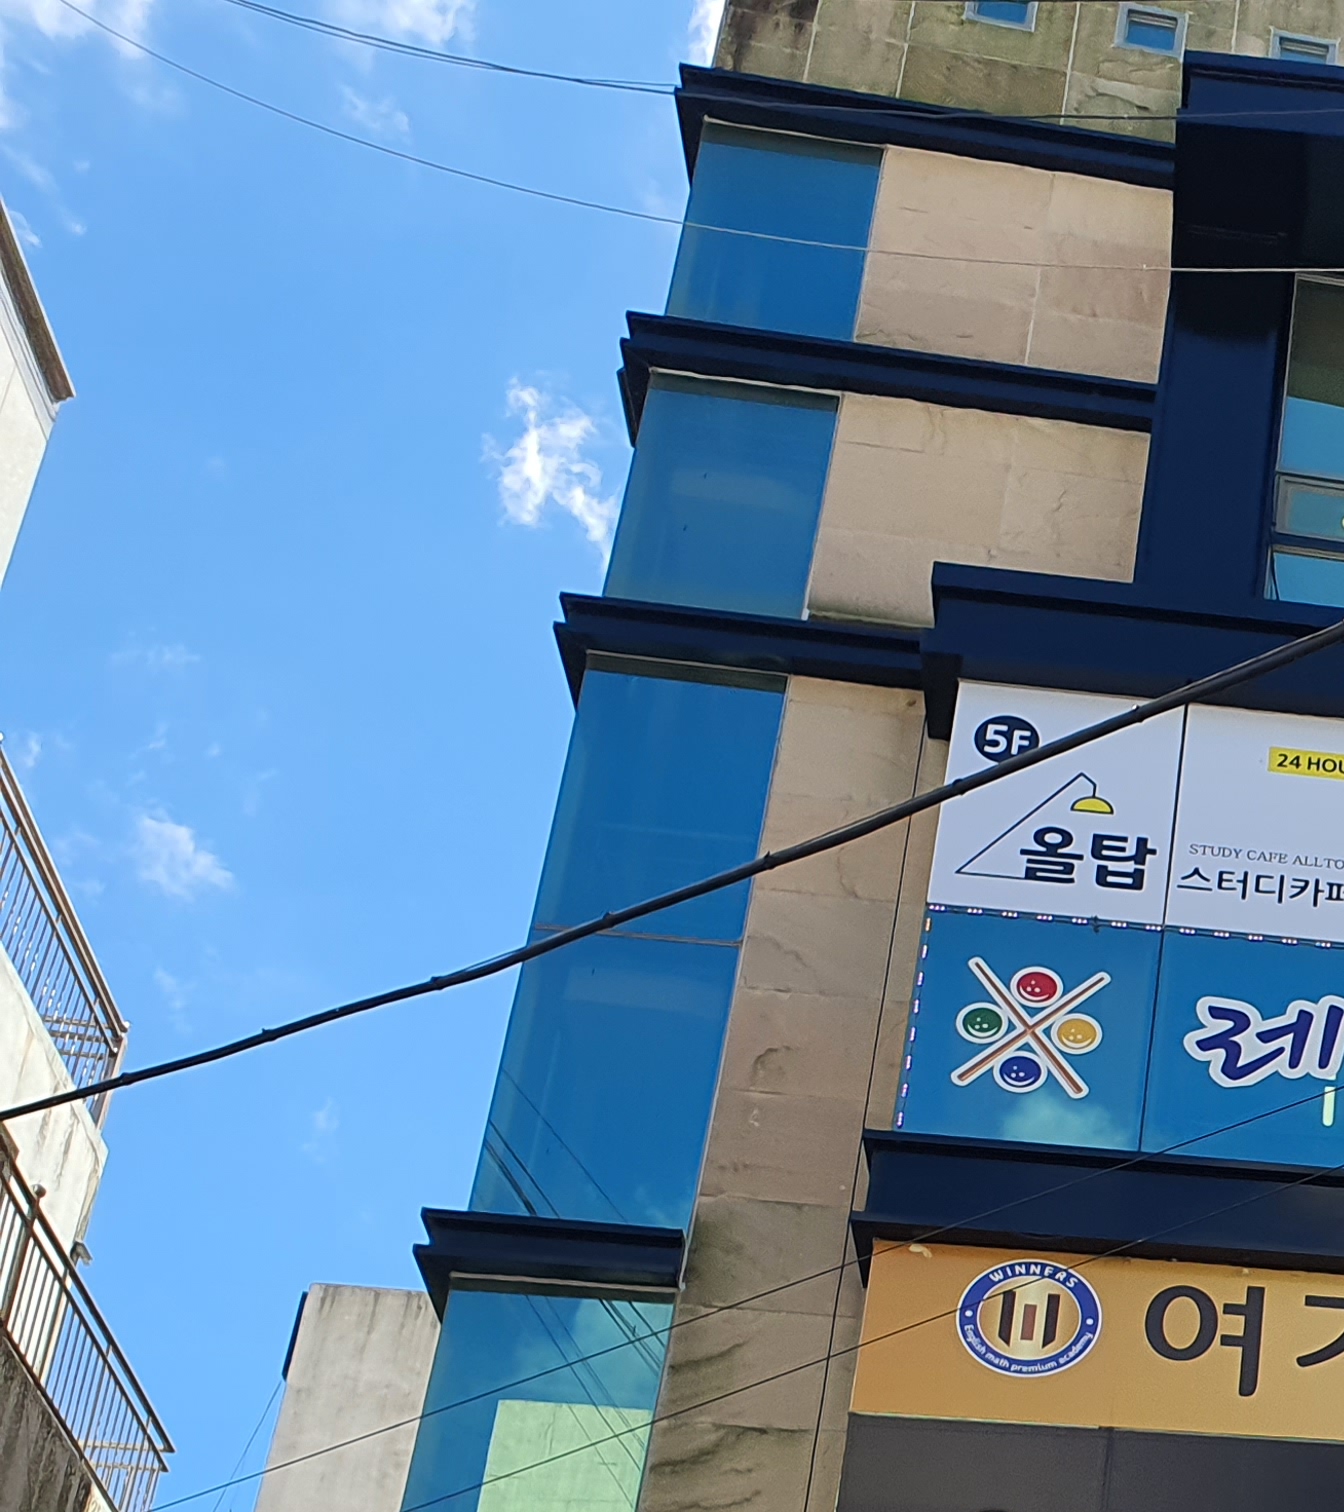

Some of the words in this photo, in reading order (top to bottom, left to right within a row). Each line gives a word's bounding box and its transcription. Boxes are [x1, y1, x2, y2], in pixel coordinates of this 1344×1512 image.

[983, 724, 1033, 757] 5F
[1276, 753, 1301, 770] 24
[1020, 826, 1157, 890] 올탑
[1189, 843, 1242, 859] STUDY
[1246, 850, 1288, 864] CAFE
[988, 1264, 1079, 1289] WINNERS
